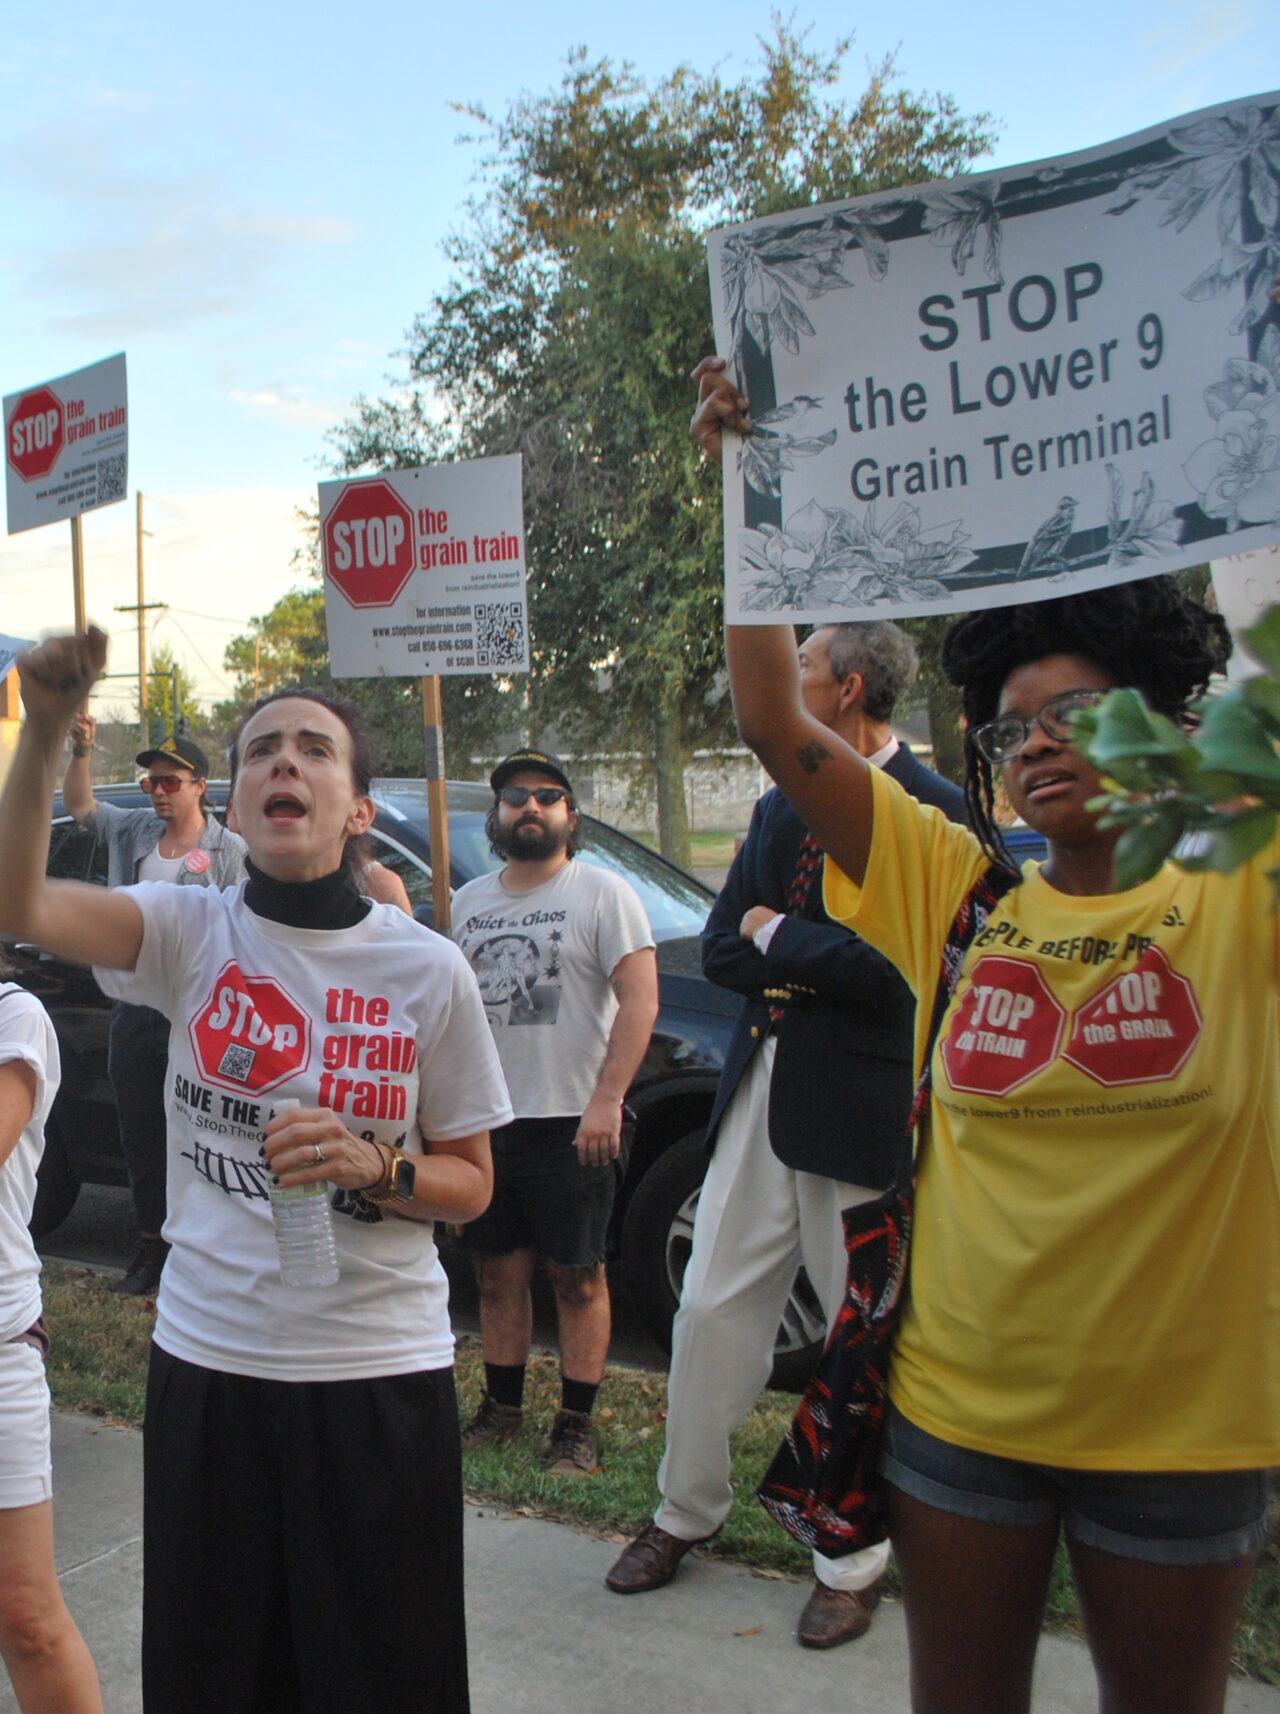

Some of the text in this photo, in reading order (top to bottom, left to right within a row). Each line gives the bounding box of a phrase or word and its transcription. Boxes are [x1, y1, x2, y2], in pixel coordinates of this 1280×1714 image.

[919, 262, 1103, 352] STOP
[844, 313, 1165, 434] the Lower 9
[66, 399, 84, 420] the
[67, 416, 95, 445] grain
[99, 405, 125, 432] train
[12, 408, 59, 457] STOP
[851, 394, 1172, 501] Grain Terminal
[418, 508, 448, 535] the
[333, 514, 405, 570] STOP
[420, 532, 519, 570] grain train
[373, 621, 472, 638] www.stopthegraintrain.com
[416, 604, 471, 619] for information
[408, 641, 420, 653] call
[446, 654, 474, 667] or scan
[466, 915, 504, 934] Quiet
[522, 910, 567, 926] Chaos
[209, 986, 298, 1052] STOP
[325, 988, 390, 1027] the
[976, 1030, 1027, 1058] TRAIN
[1083, 1018, 1173, 1045] the GRAIN
[323, 1031, 416, 1074] grain
[175, 1073, 212, 1113] SAVE
[221, 1095, 261, 1127] THE
[318, 1072, 407, 1121] train
[970, 1104, 1020, 1119] lower9
[1024, 1103, 1062, 1119] from
[1065, 1085, 1214, 1117] reindustrialization!
